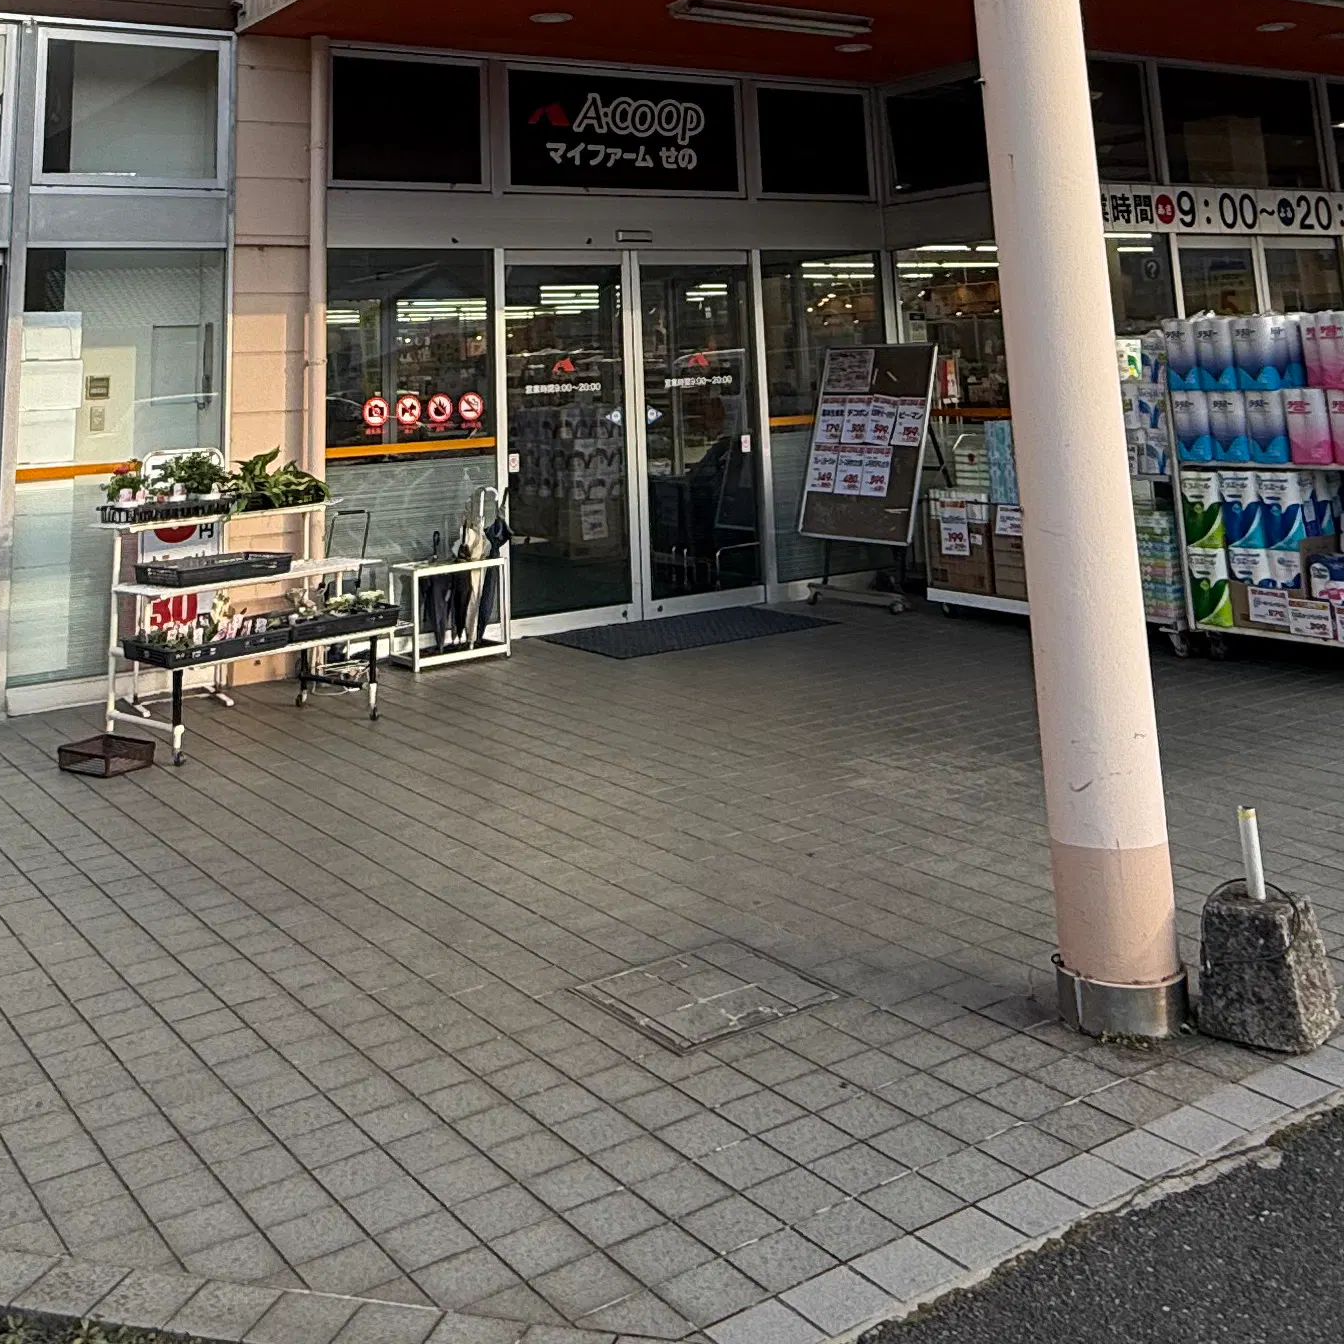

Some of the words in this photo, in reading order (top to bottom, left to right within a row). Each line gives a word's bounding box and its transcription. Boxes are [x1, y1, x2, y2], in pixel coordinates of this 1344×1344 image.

[545, 142, 654, 168] マイファーム
[658, 146, 698, 170] せの
